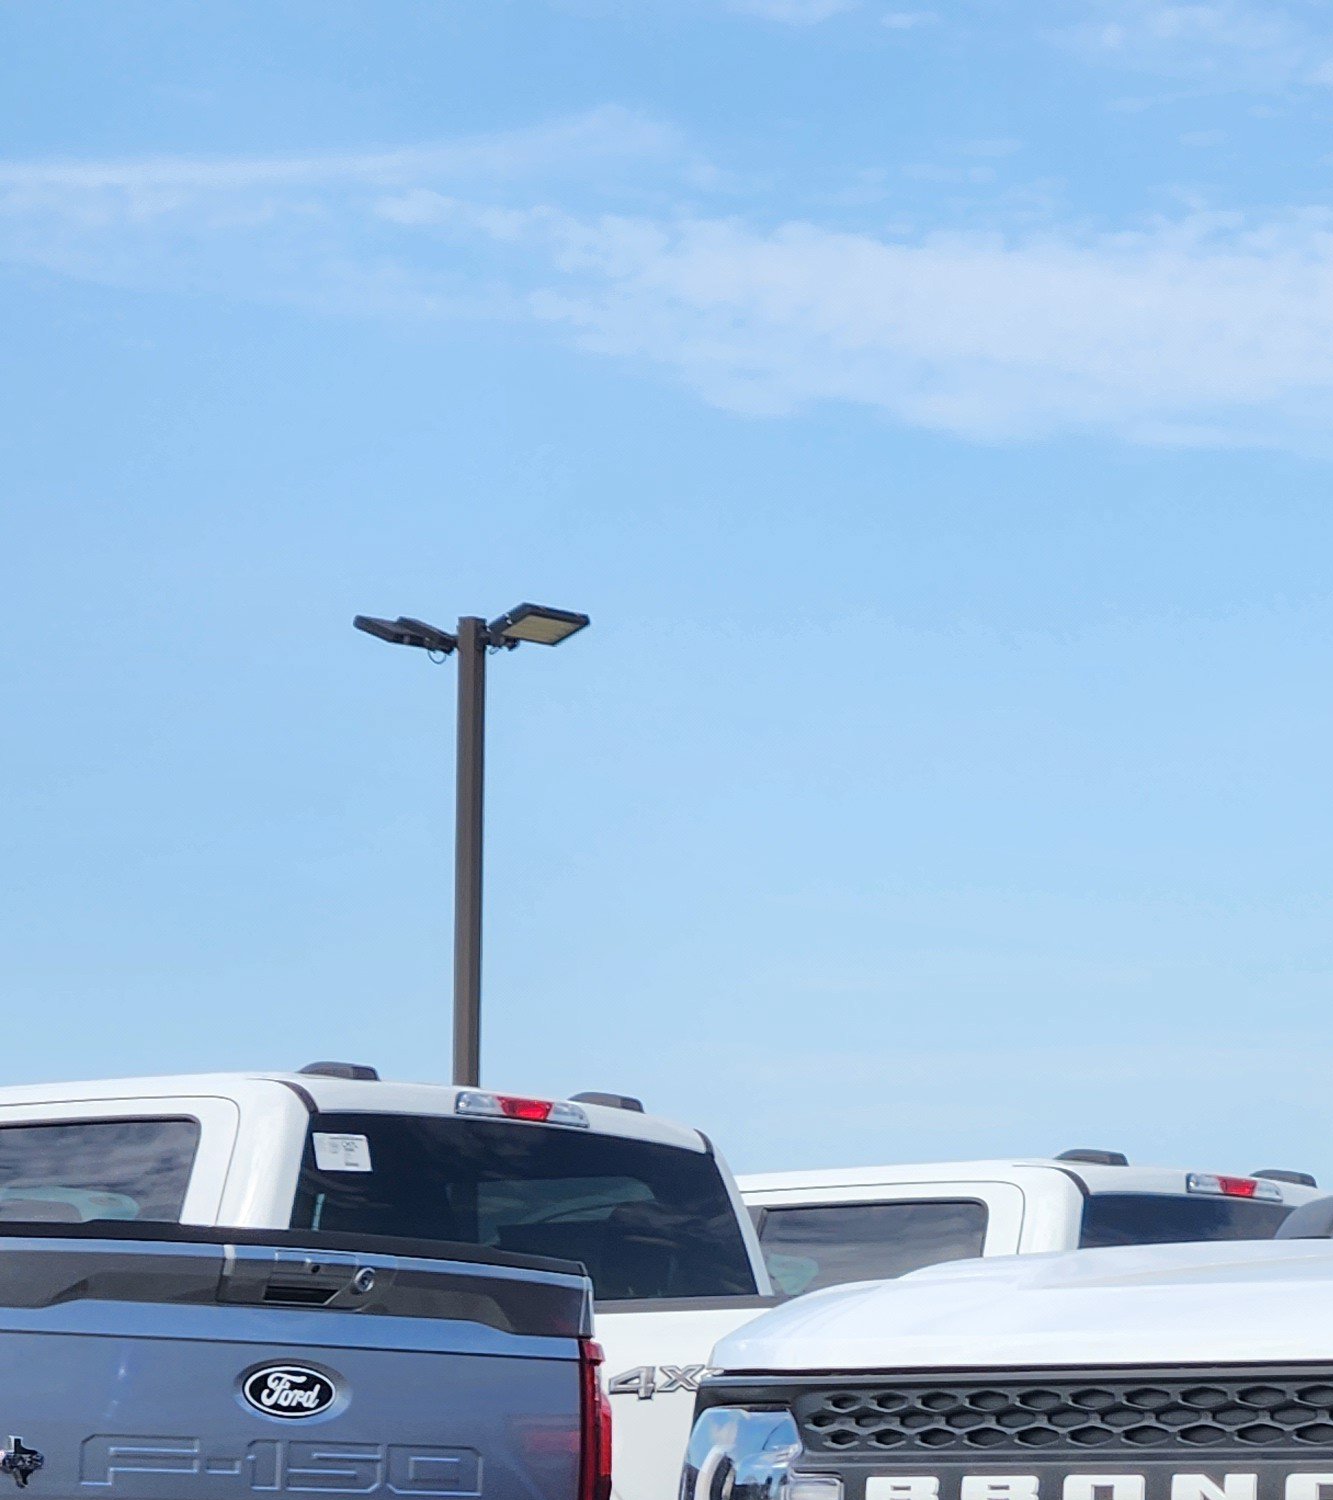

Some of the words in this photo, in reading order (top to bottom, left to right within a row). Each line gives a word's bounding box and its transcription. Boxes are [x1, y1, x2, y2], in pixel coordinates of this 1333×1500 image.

[260, 1372, 321, 1409] Ford
[608, 1364, 706, 1400] 4X
[80, 1434, 483, 1497] F-150
